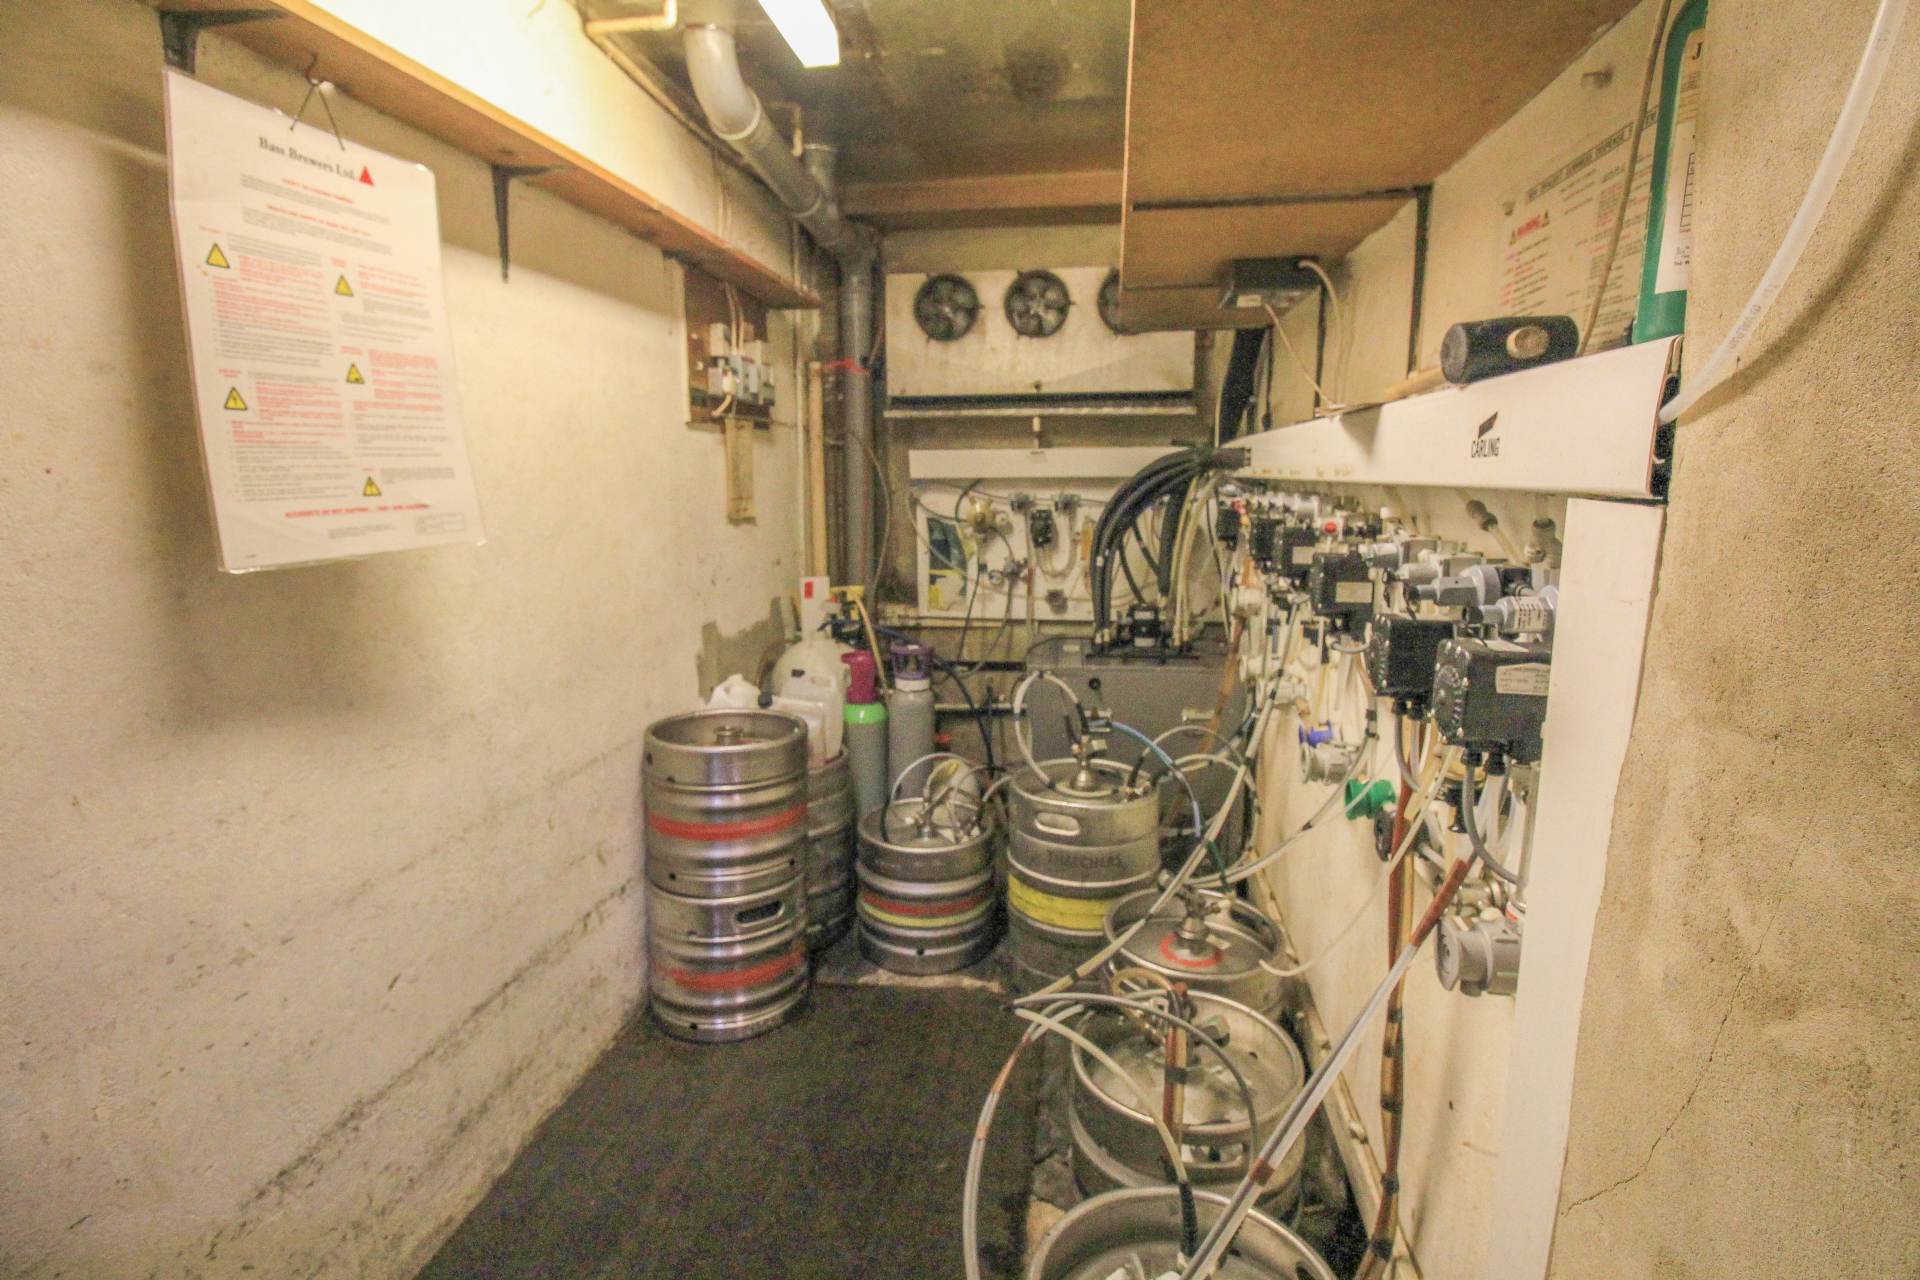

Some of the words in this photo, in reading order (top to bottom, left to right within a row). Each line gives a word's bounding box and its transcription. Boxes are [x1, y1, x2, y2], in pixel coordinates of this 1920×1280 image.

[258, 135, 286, 157] Bass
[288, 146, 334, 173] Brewers
[1471, 437, 1500, 459] CARLING
